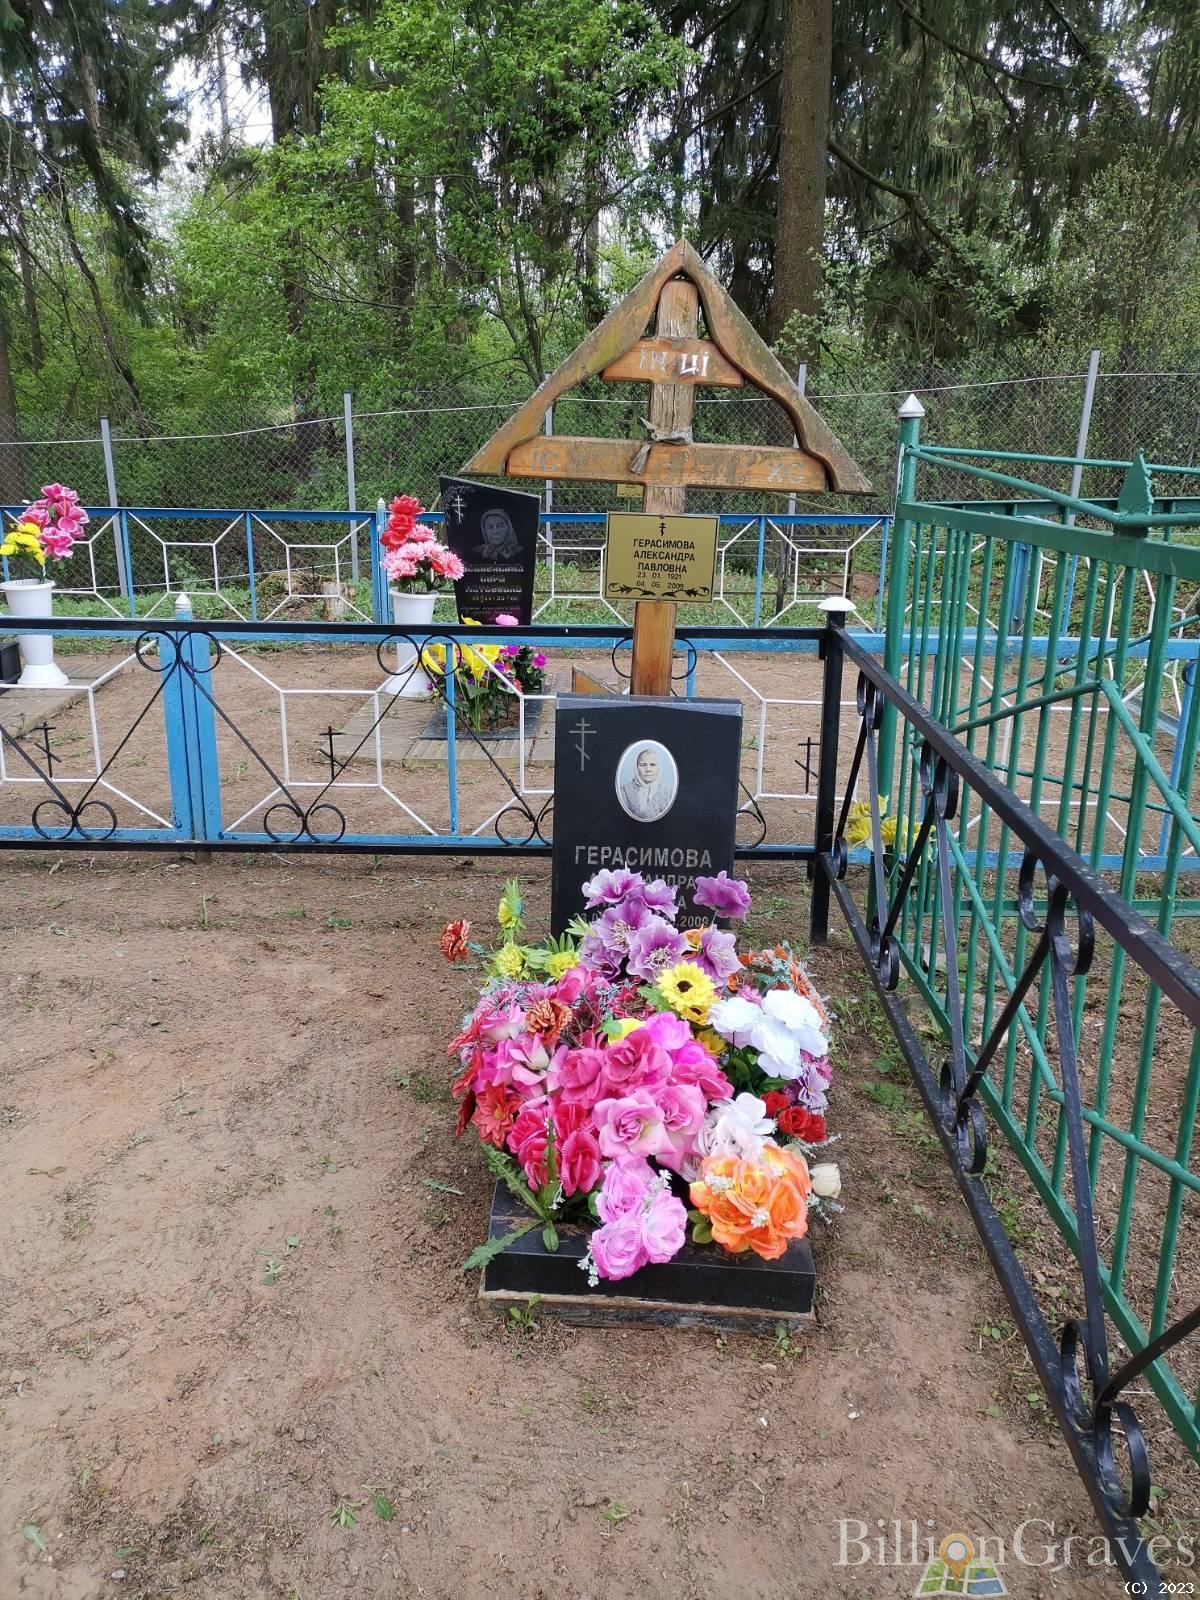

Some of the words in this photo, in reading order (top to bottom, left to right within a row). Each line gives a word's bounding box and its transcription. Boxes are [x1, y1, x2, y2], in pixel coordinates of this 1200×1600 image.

[633, 538, 696, 550] ГЕРАСИМОВА
[633, 550, 696, 562] АЛЕКСАНДРА
[637, 562, 688, 573] ПАВЛОВНА
[574, 845, 713, 869] ГЕРАСИМОВА
